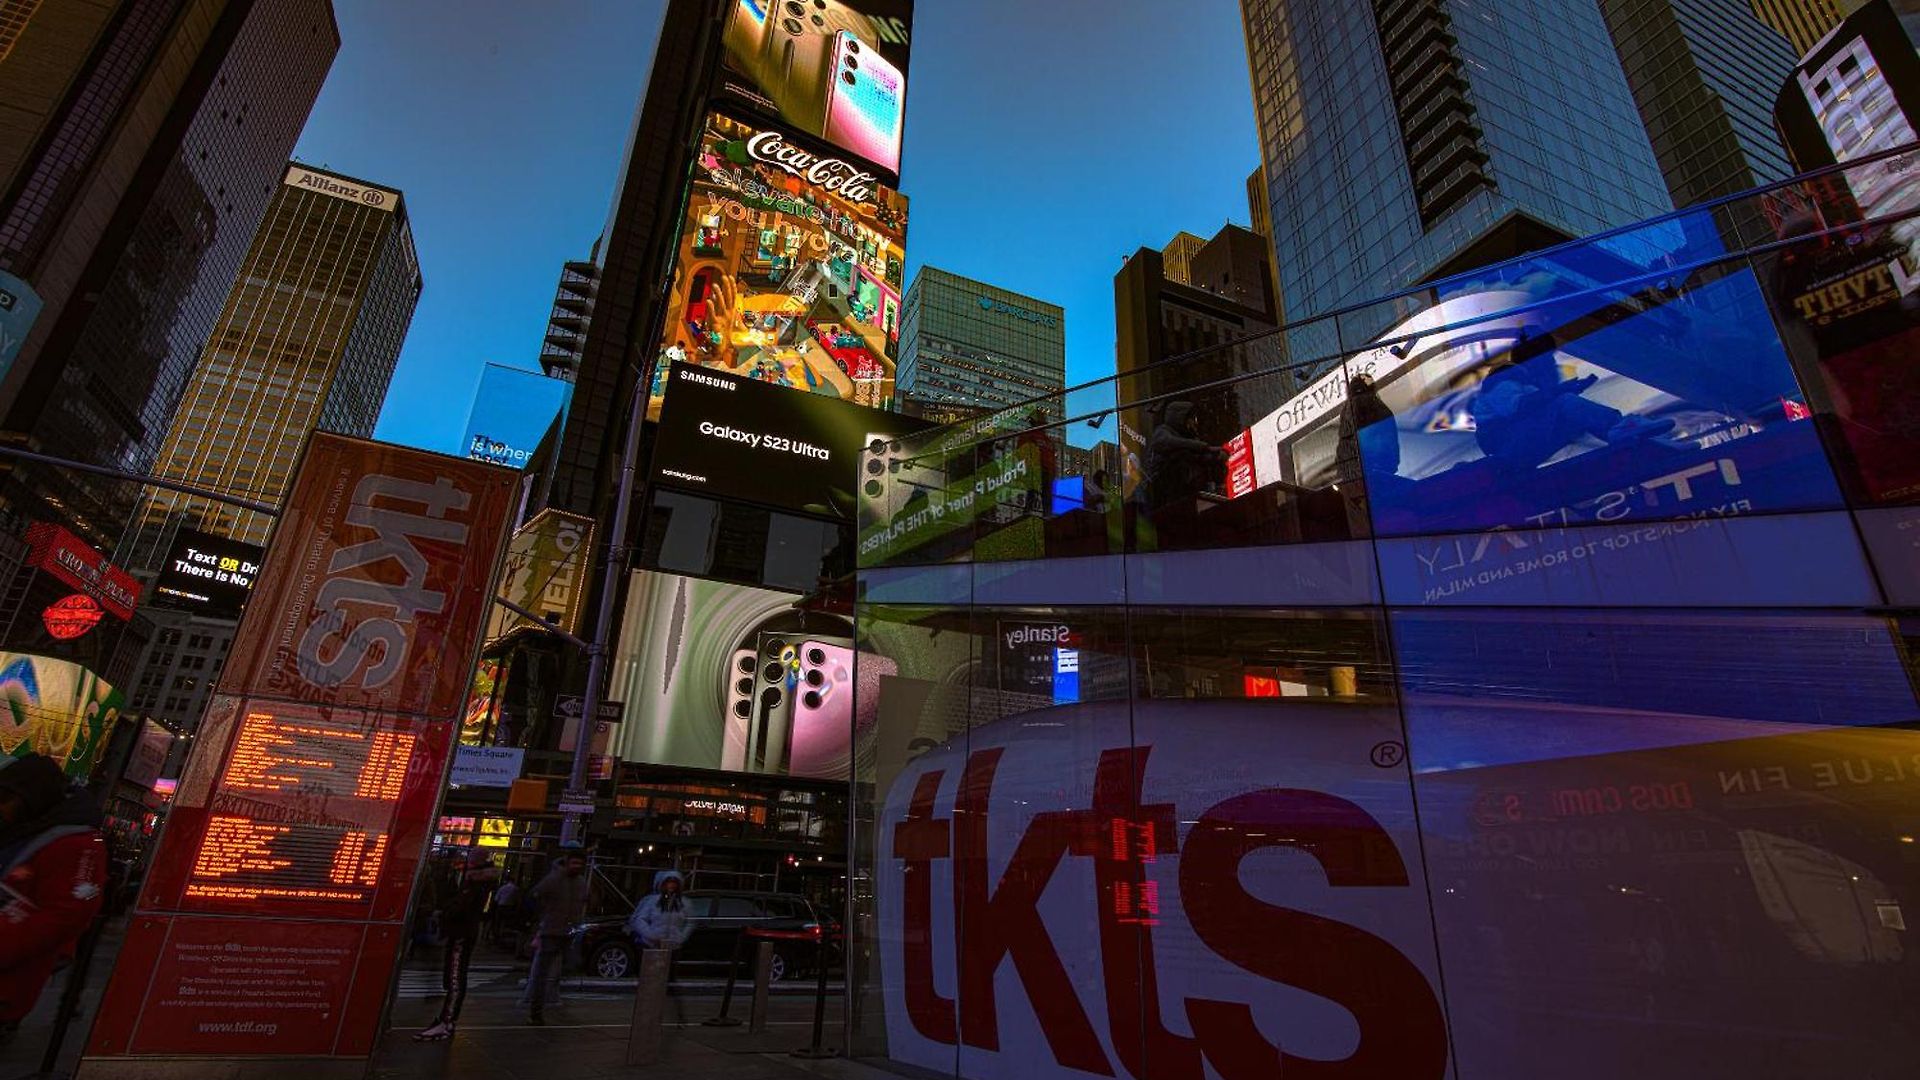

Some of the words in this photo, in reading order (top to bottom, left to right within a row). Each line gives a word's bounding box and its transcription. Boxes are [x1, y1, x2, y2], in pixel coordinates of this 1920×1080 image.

[298, 173, 359, 198] Allianz
[746, 131, 877, 203] Coca-Cola
[707, 190, 768, 229] you
[711, 168, 824, 226] elevate
[680, 370, 737, 391] SAMSUNG
[699, 421, 761, 448] Galaxy
[762, 435, 791, 452] S23
[791, 439, 830, 461] Ultra
[187, 548, 218, 565] Text
[219, 557, 239, 572] OR
[306, 530, 332, 570] Theatre
[175, 559, 214, 578] There
[230, 573, 248, 586] No
[297, 473, 472, 689] tkts
[279, 576, 317, 652] Development
[893, 746, 1448, 1080] tkts
[199, 1021, 278, 1035] www.tdf.org
